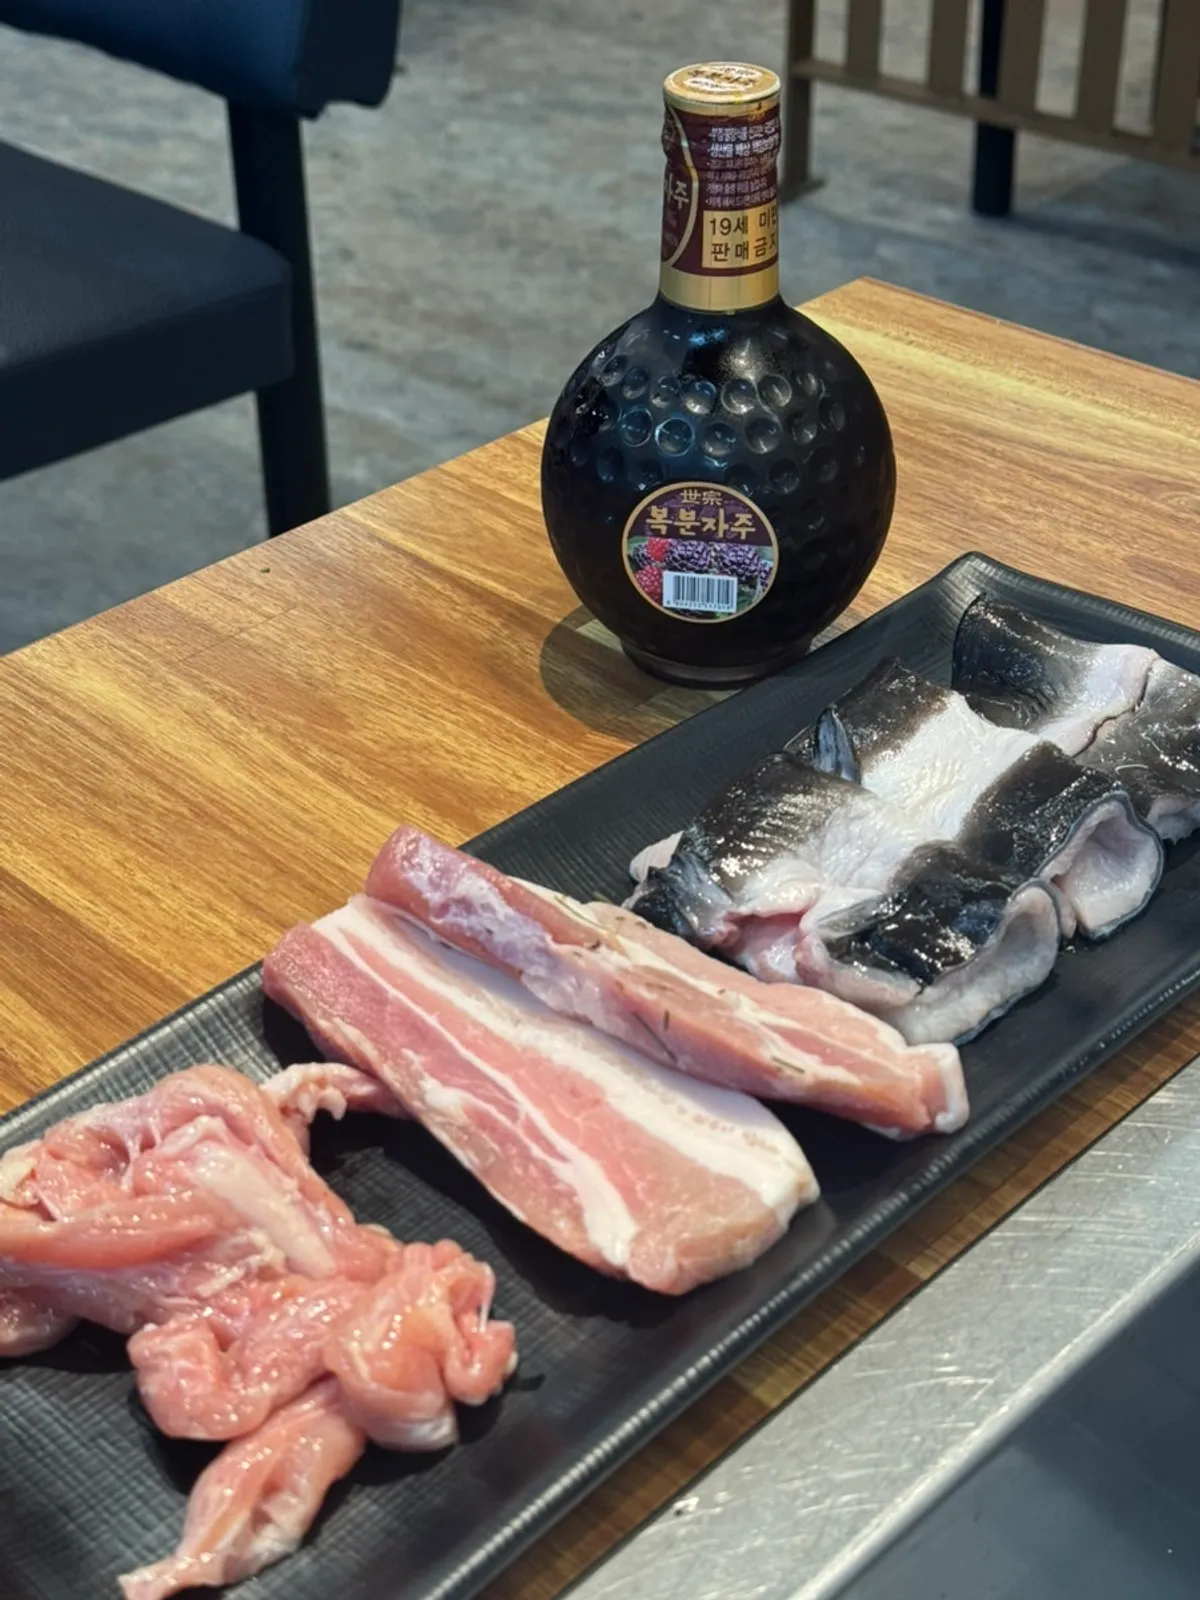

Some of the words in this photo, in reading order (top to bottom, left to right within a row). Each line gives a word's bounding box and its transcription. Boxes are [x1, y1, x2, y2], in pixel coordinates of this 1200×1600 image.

[709, 215, 749, 236] 19세
[679, 488, 724, 506] 世宗
[645, 504, 757, 541] 복분자주
